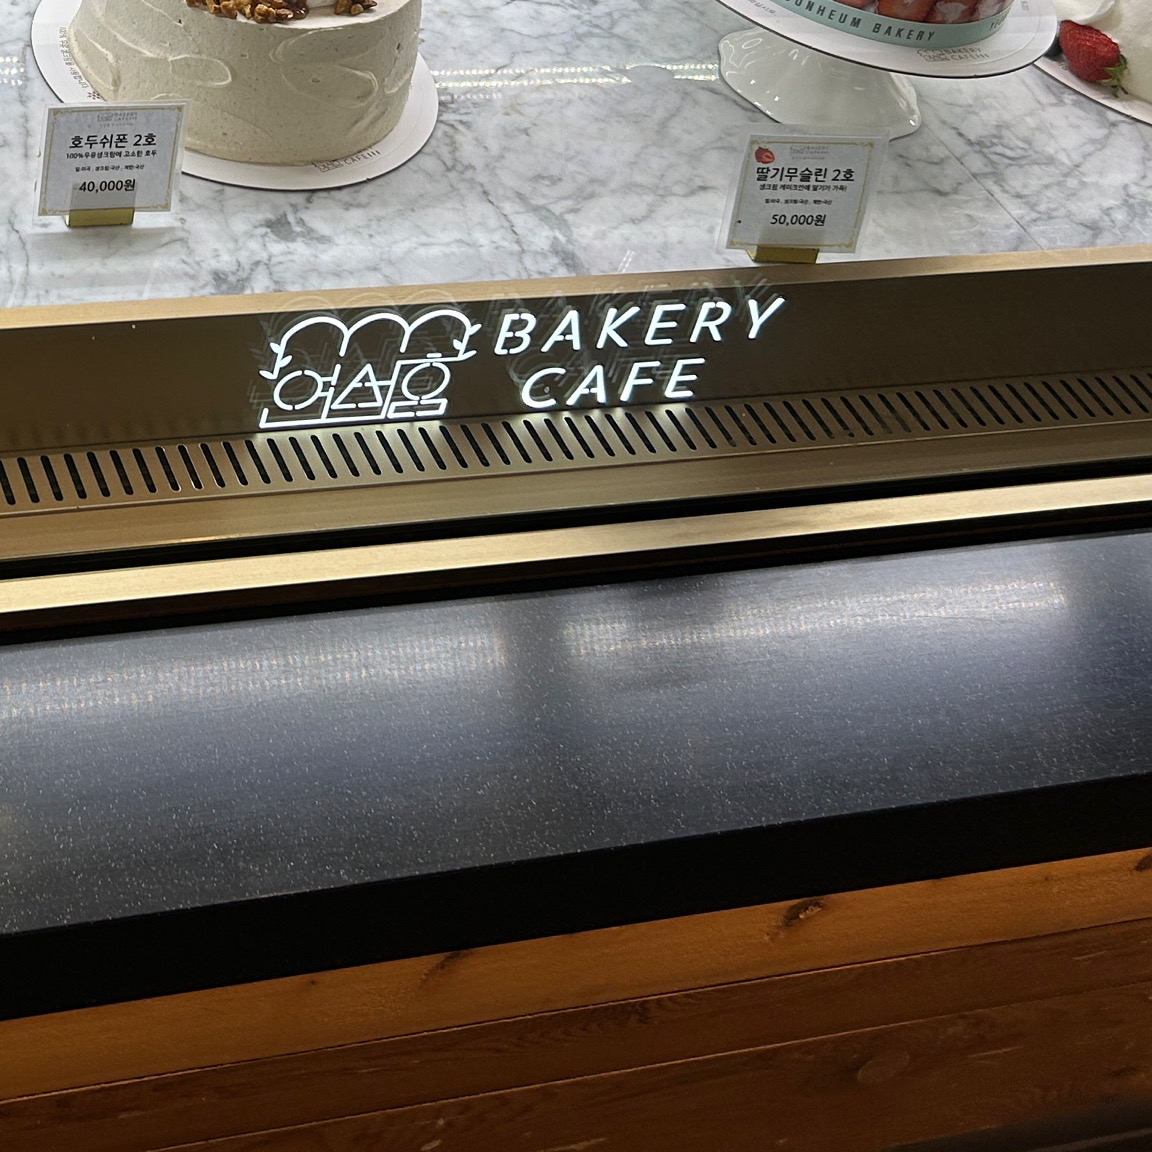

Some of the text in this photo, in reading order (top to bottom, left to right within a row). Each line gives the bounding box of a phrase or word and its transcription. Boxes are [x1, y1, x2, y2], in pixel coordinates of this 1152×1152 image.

[872, 22, 935, 42] BAKERY
[69, 132, 157, 149] 호두쉬폰 2호
[124, 150, 143, 158] 고소한
[756, 167, 855, 183] 딸기무슬린 2호
[79, 178, 136, 194] 40,000원
[770, 214, 827, 227] 50,000원
[493, 297, 786, 356] BAKERY
[519, 357, 707, 409] CAFE
